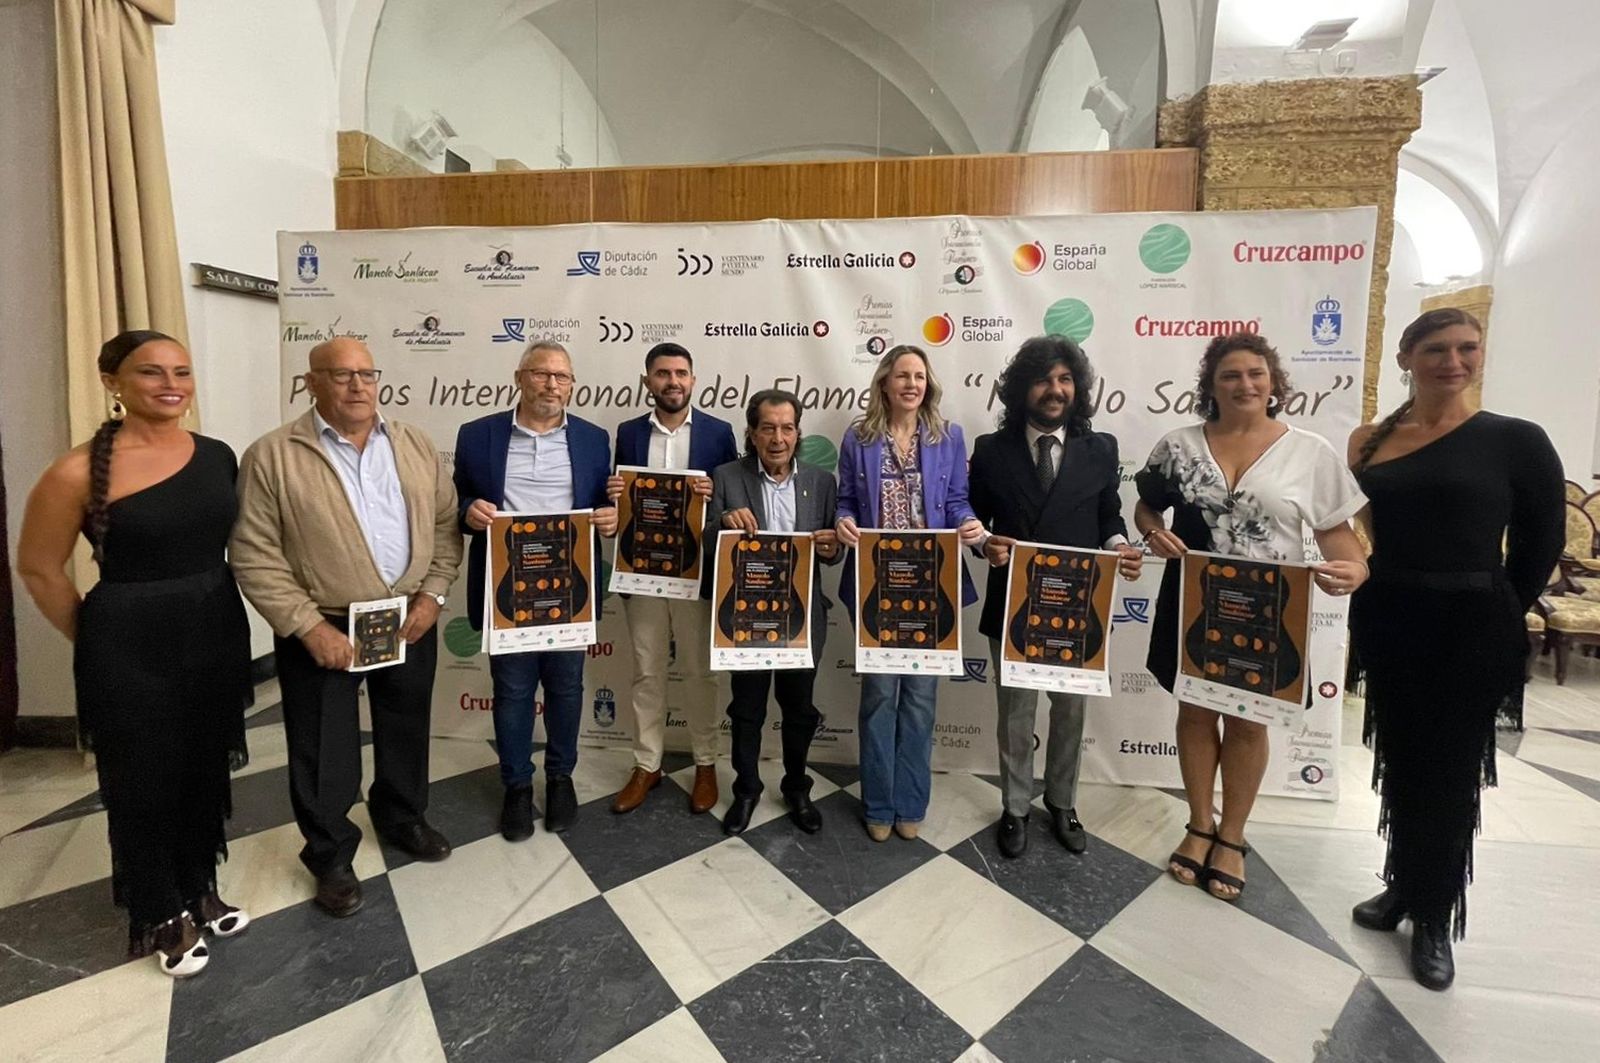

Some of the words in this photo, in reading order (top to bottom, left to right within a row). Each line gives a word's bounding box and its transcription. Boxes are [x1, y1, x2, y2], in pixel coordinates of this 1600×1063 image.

[604, 250, 658, 263] Diputación
[1054, 244, 1106, 258] España
[1233, 240, 1365, 264] Cruzcampo
[786, 253, 840, 268] Estrella
[842, 252, 895, 268] Galicia
[1053, 258, 1096, 270] Global
[353, 263, 393, 279] Manolo
[394, 258, 439, 279] Sanlúcar
[604, 266, 618, 276] de
[620, 265, 648, 276] Cádiz
[206, 270, 241, 286] SALA
[244, 280, 256, 288] DE
[529, 318, 580, 330] Diputación
[704, 322, 757, 337] Estrella
[760, 321, 809, 337] Galicia
[962, 316, 1013, 330] España
[283, 326, 322, 342] Manolo
[542, 332, 570, 343] Cádiz
[962, 330, 1004, 342] Global
[699, 374, 750, 409] del
[942, 736, 970, 748] Cádiz
[1119, 739, 1177, 756] Estrella
